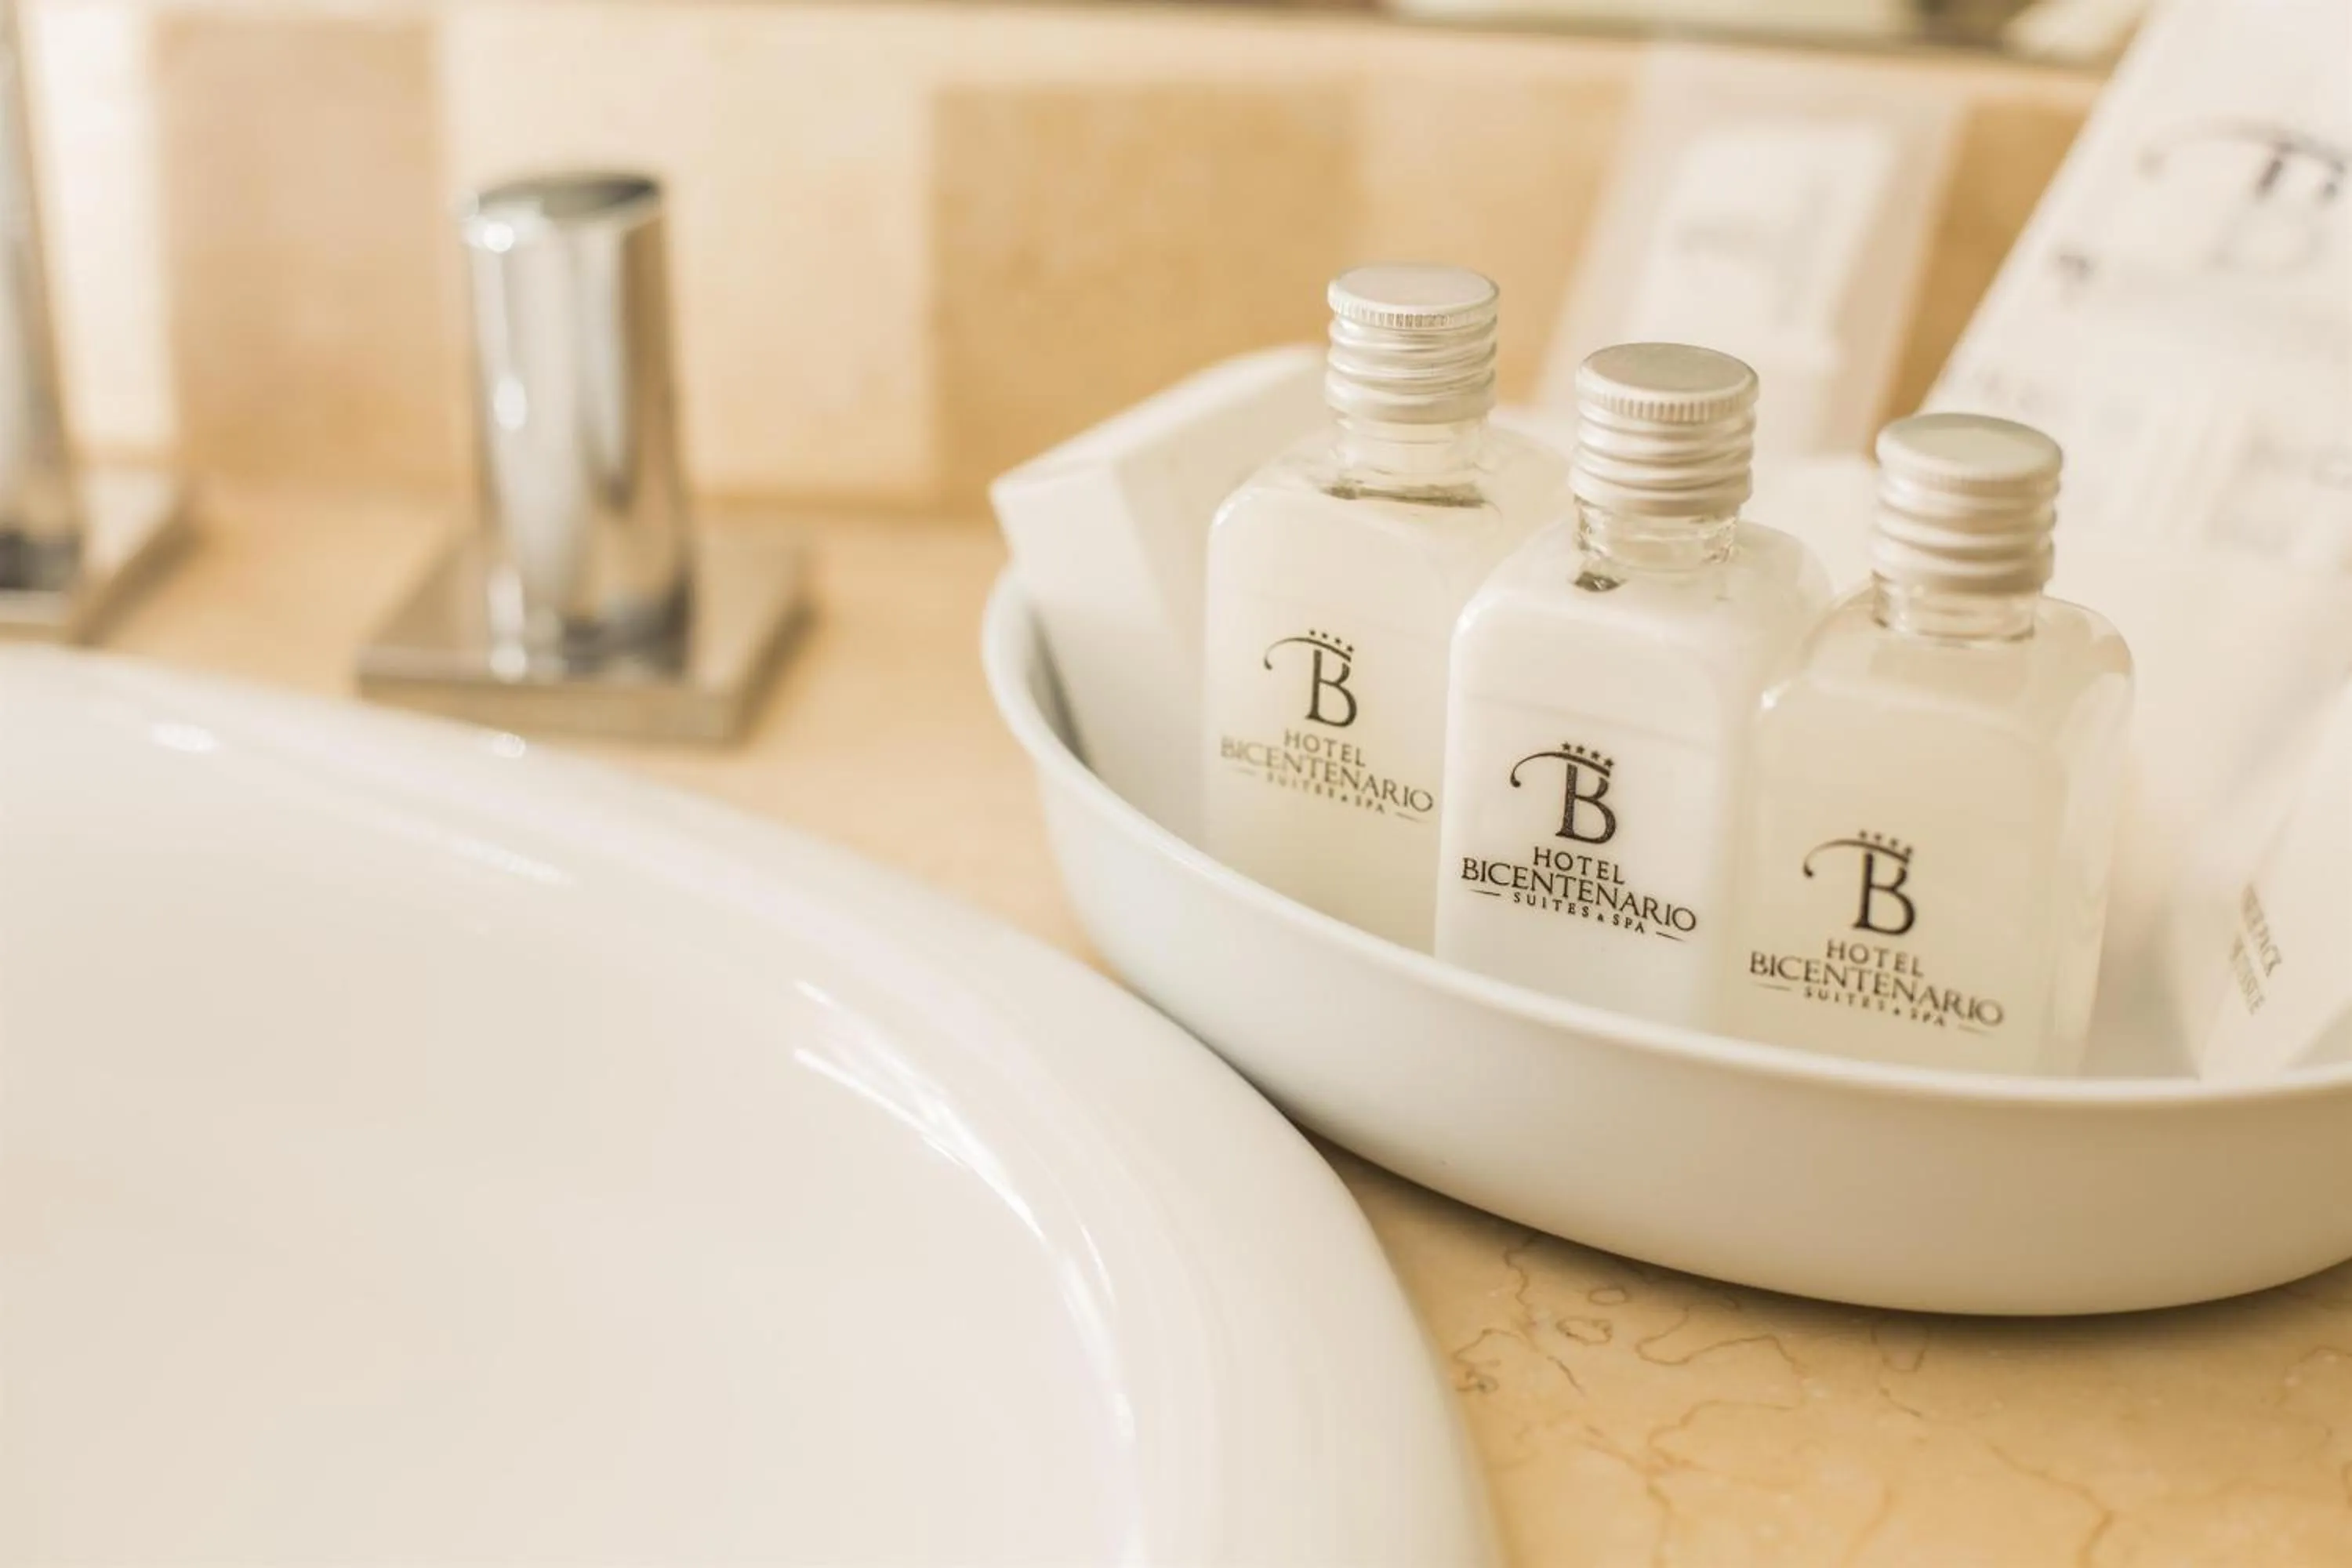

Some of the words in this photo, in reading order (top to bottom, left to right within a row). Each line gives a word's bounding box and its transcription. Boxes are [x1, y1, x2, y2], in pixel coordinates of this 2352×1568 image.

[1284, 728, 1367, 768] HOTEL
[1220, 735, 1434, 813] BICENTENARIO
[1354, 795, 1386, 814] SPA
[1533, 846, 1625, 885] HOTEL
[1461, 857, 1697, 932] BICENTENARIO
[1514, 891, 1590, 918] SUITES
[1612, 913, 1646, 934] SPA
[1826, 939, 1924, 978] HOTEL
[1749, 950, 2004, 1027] BICENTENARIO
[1804, 985, 1886, 1013] SUITES
[1910, 1007, 1946, 1027] SPA
